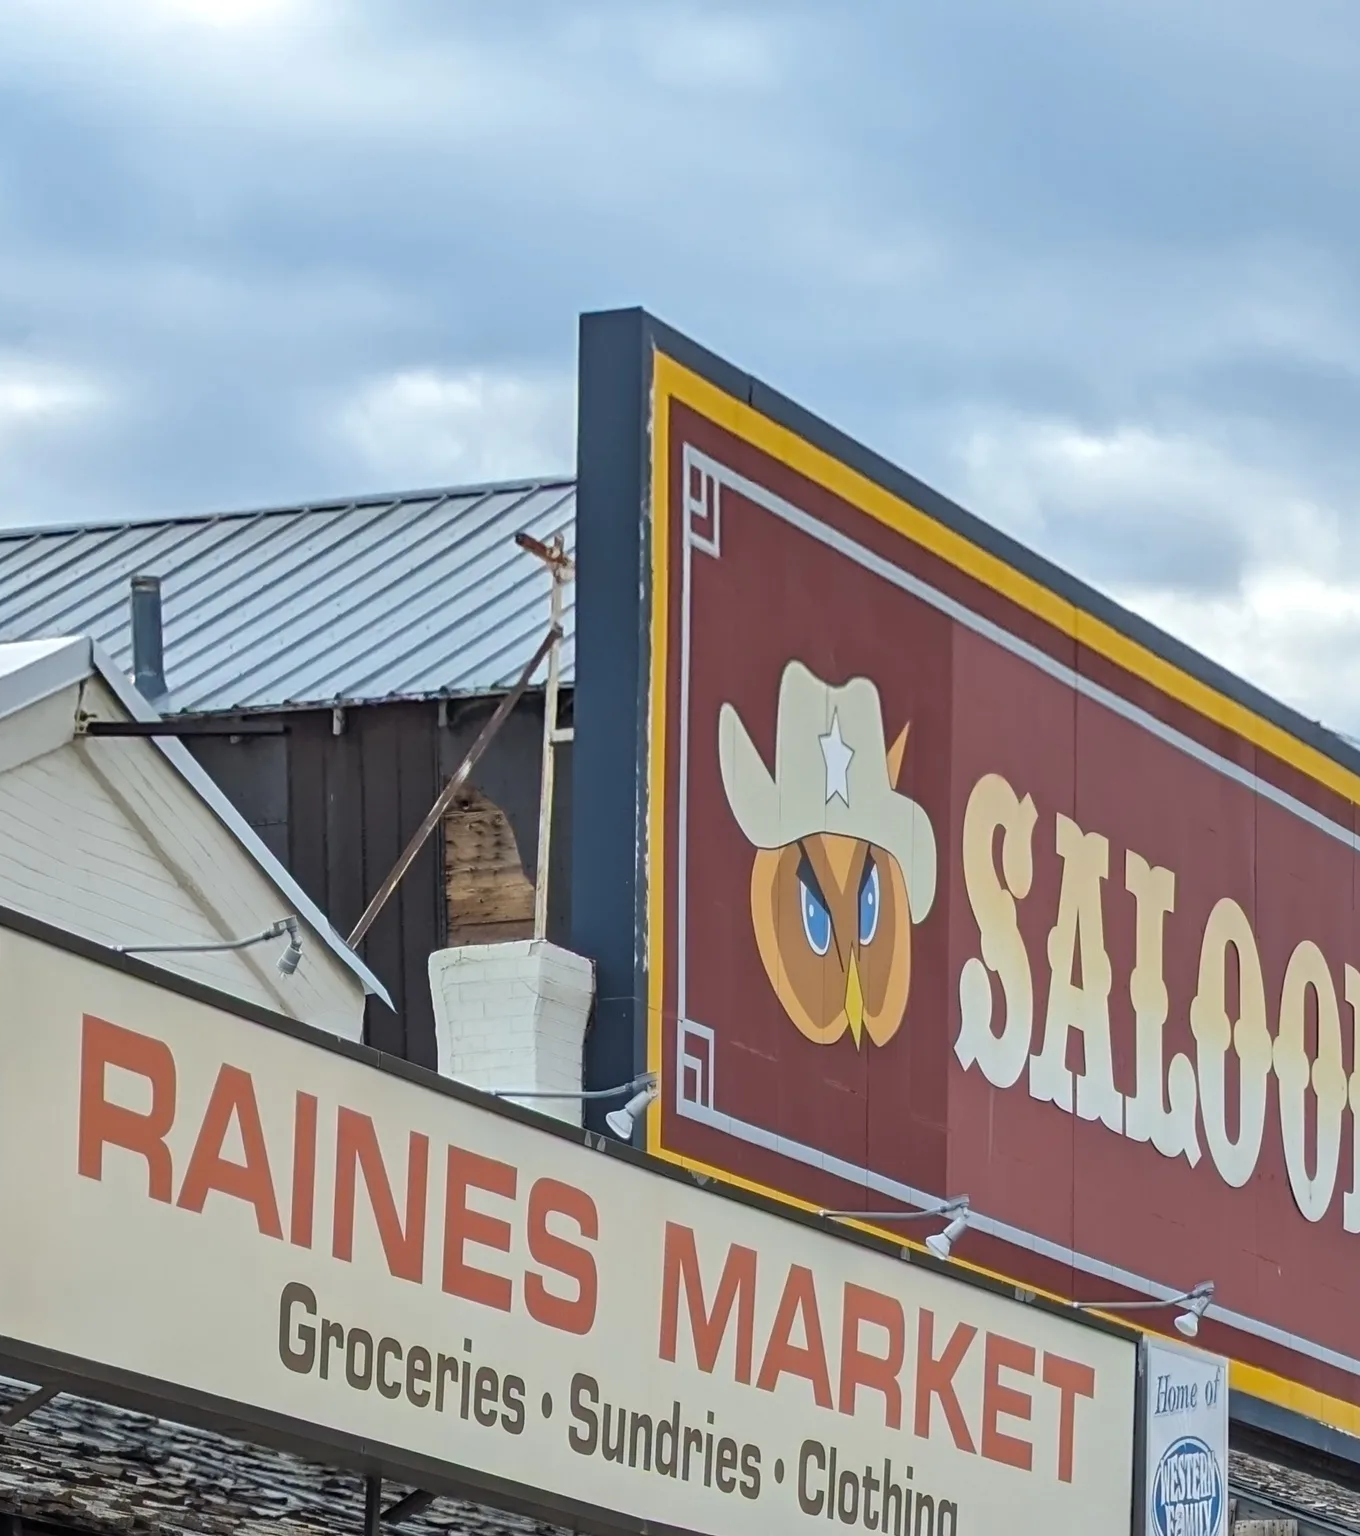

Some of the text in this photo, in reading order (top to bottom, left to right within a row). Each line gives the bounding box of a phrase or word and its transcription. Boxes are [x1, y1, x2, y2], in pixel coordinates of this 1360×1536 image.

[77, 1012, 1096, 1485] RAINES MARKET
[278, 1281, 526, 1435] Groceries
[568, 1372, 761, 1500] Sundries
[1155, 1365, 1221, 1415] Home of
[1160, 1449, 1217, 1507] WESTERN
